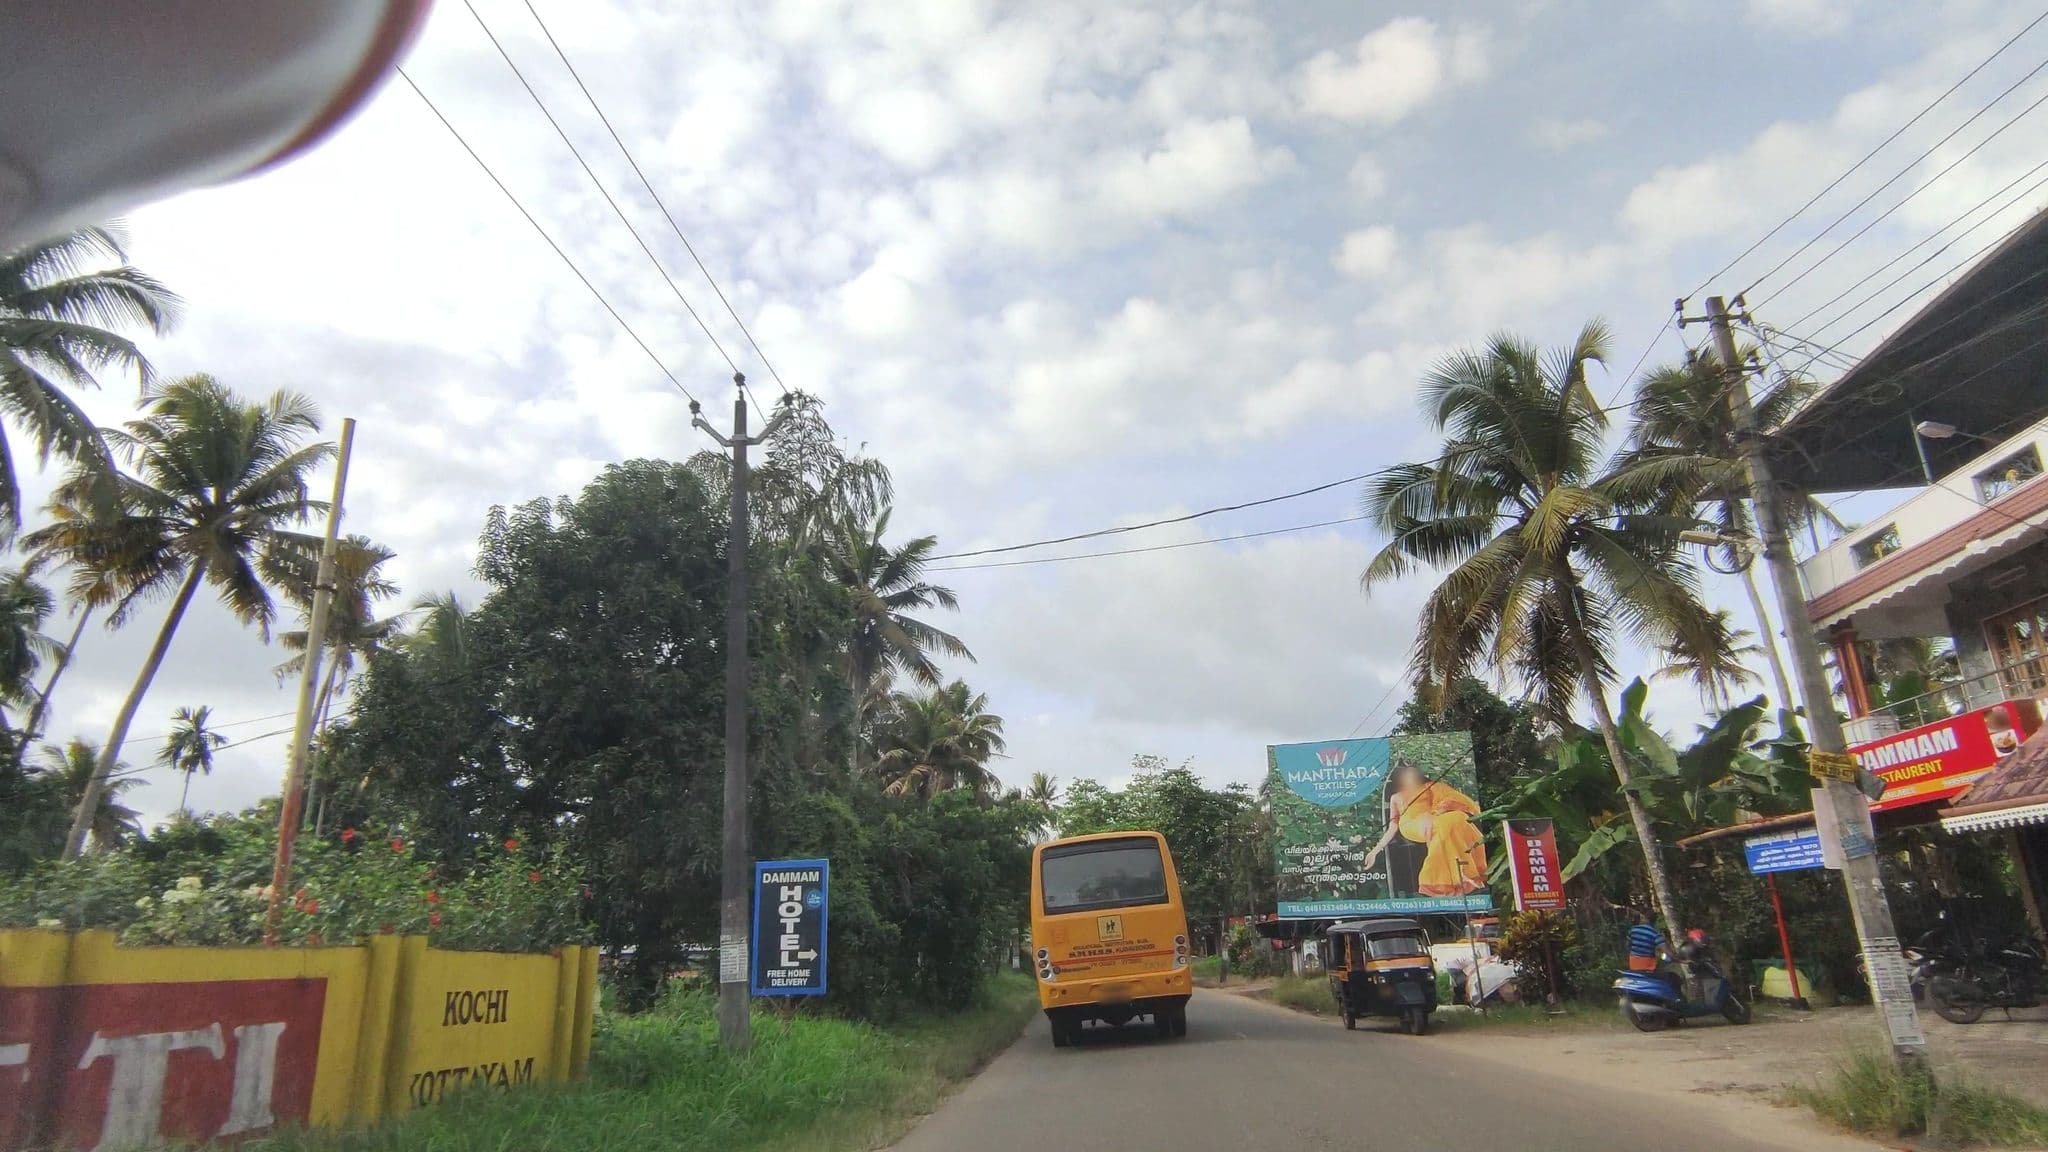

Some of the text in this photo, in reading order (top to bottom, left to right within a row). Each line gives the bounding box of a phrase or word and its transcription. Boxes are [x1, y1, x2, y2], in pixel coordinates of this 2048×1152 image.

[1288, 766, 1380, 783] MANTHARA
[1880, 759, 1943, 784] STAURENT
[1313, 780, 1358, 790] TEXTILES
[1526, 840, 1550, 892] DAMMAM
[762, 871, 820, 883] DAMMAM
[778, 885, 803, 967] HOTEL
[767, 969, 811, 978] FREE HOME
[771, 978, 808, 986] DELIVERY
[442, 989, 509, 1027] KOCHI
